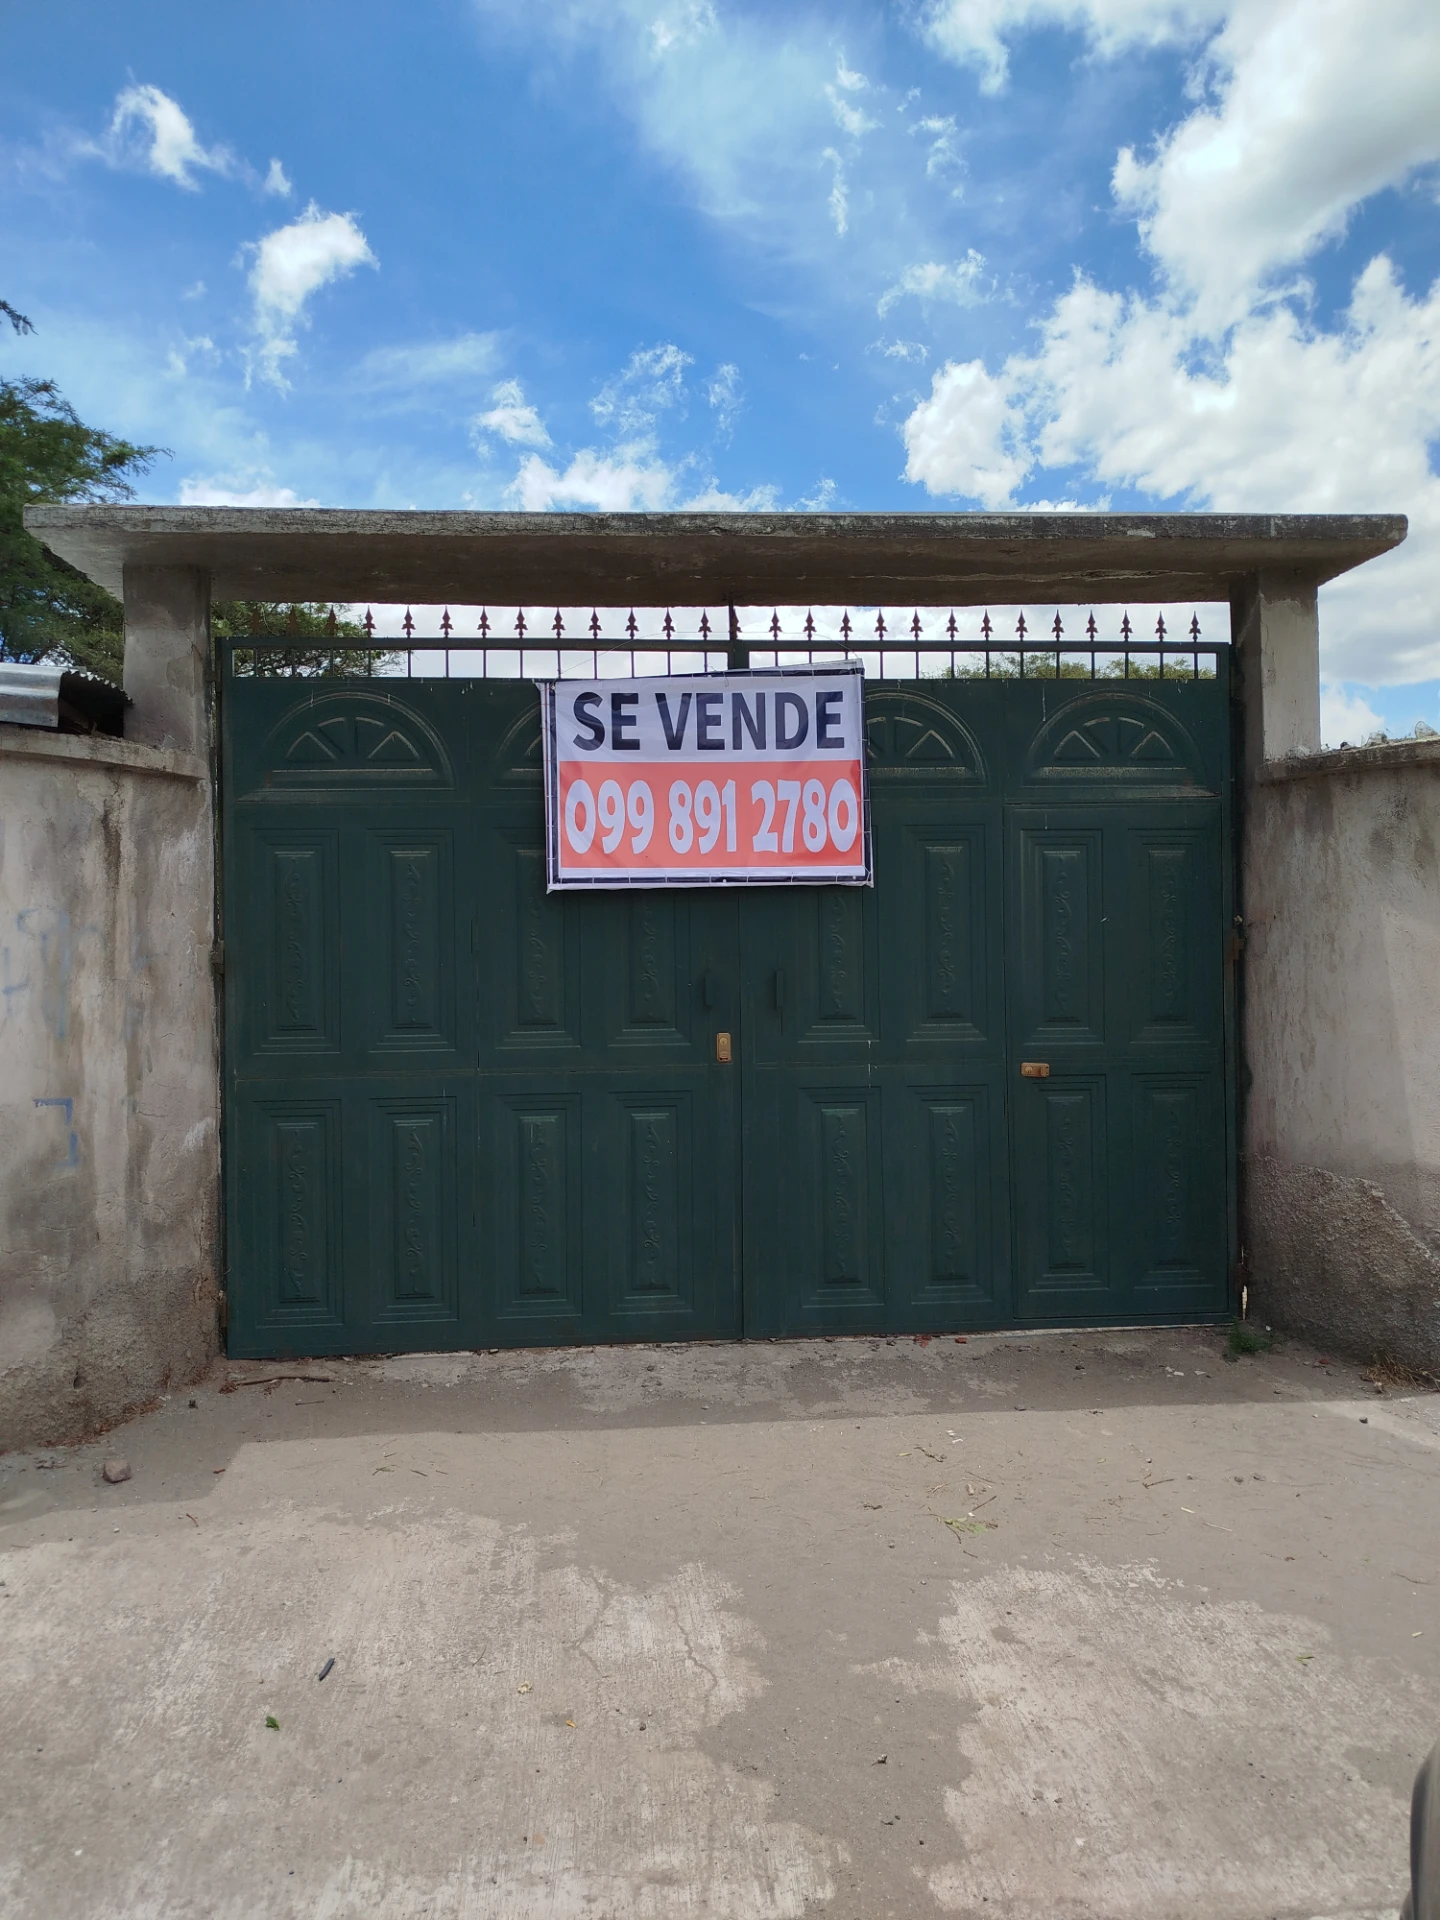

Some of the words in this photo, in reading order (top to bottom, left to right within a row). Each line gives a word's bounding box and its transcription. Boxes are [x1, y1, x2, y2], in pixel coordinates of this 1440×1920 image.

[572, 691, 641, 751] SE
[655, 691, 845, 751] VENDE
[565, 779, 655, 855] 099
[668, 779, 737, 855] 891
[751, 778, 858, 854] 2780
